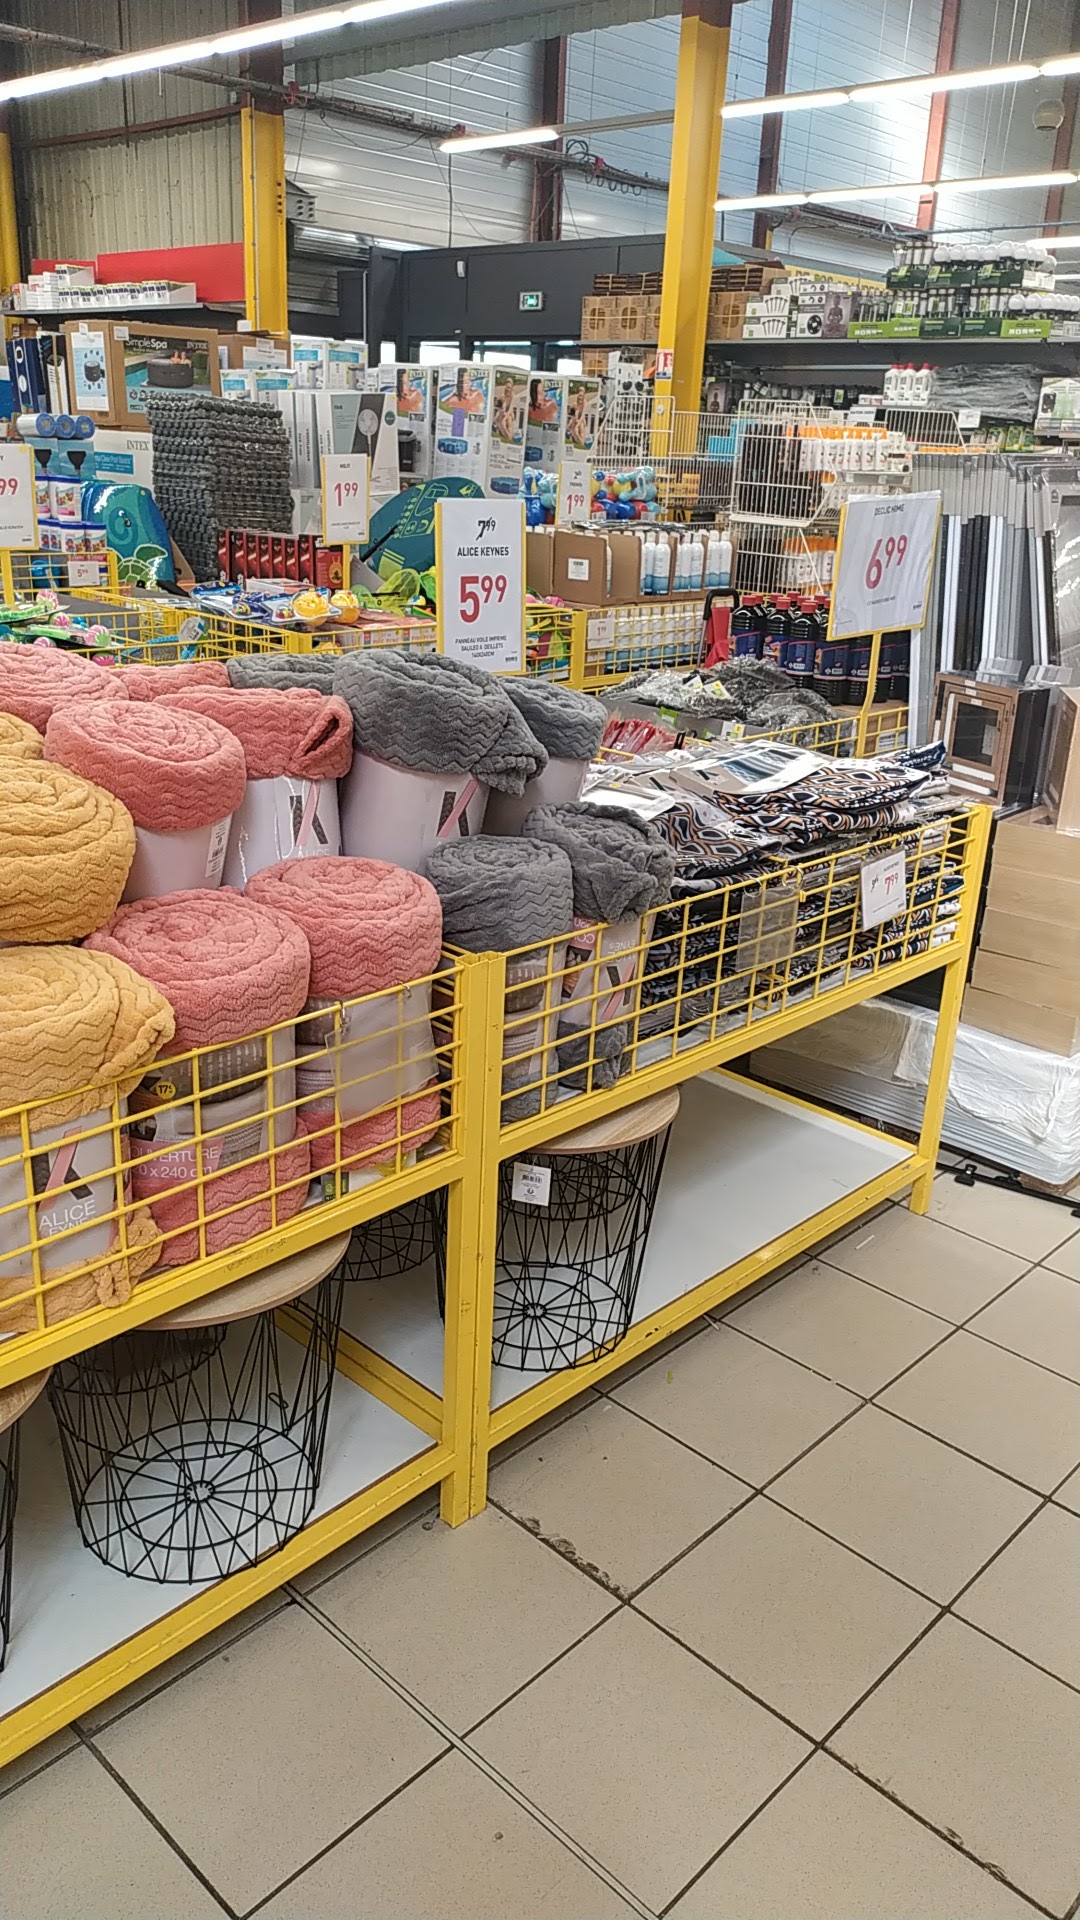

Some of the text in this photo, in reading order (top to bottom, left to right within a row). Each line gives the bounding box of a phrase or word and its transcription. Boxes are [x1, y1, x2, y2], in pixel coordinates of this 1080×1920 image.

[127, 440, 149, 451] INTEX
[457, 546, 509, 557] ALICE KEYNES
[149, 1167, 159, 1178] x
[161, 1166, 187, 1179] 240
[39, 1199, 96, 1231] ALICE
